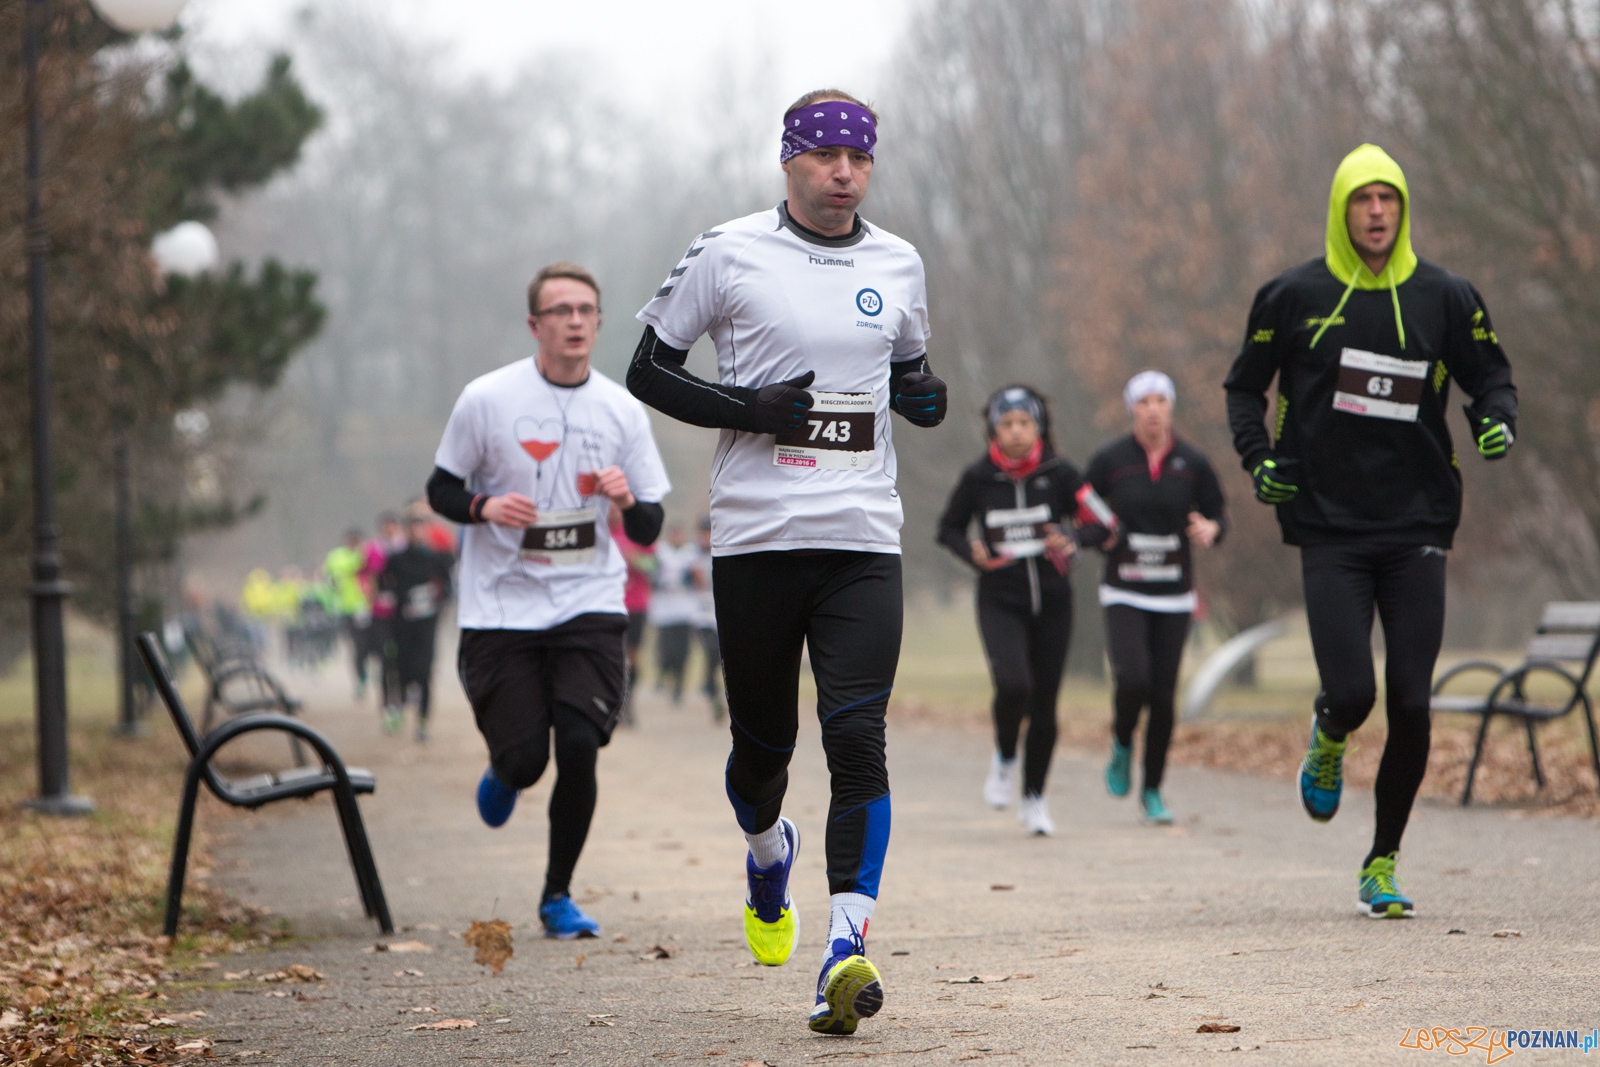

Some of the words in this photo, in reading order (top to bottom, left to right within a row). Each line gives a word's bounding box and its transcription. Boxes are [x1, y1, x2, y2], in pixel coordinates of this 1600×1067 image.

[808, 255, 855, 268] hummel
[856, 320, 884, 331] ZDROWIE
[1366, 375, 1394, 397] 63
[807, 419, 851, 443] 743
[778, 458, 810, 466] 14.02.2016
[544, 528, 579, 549] 554
